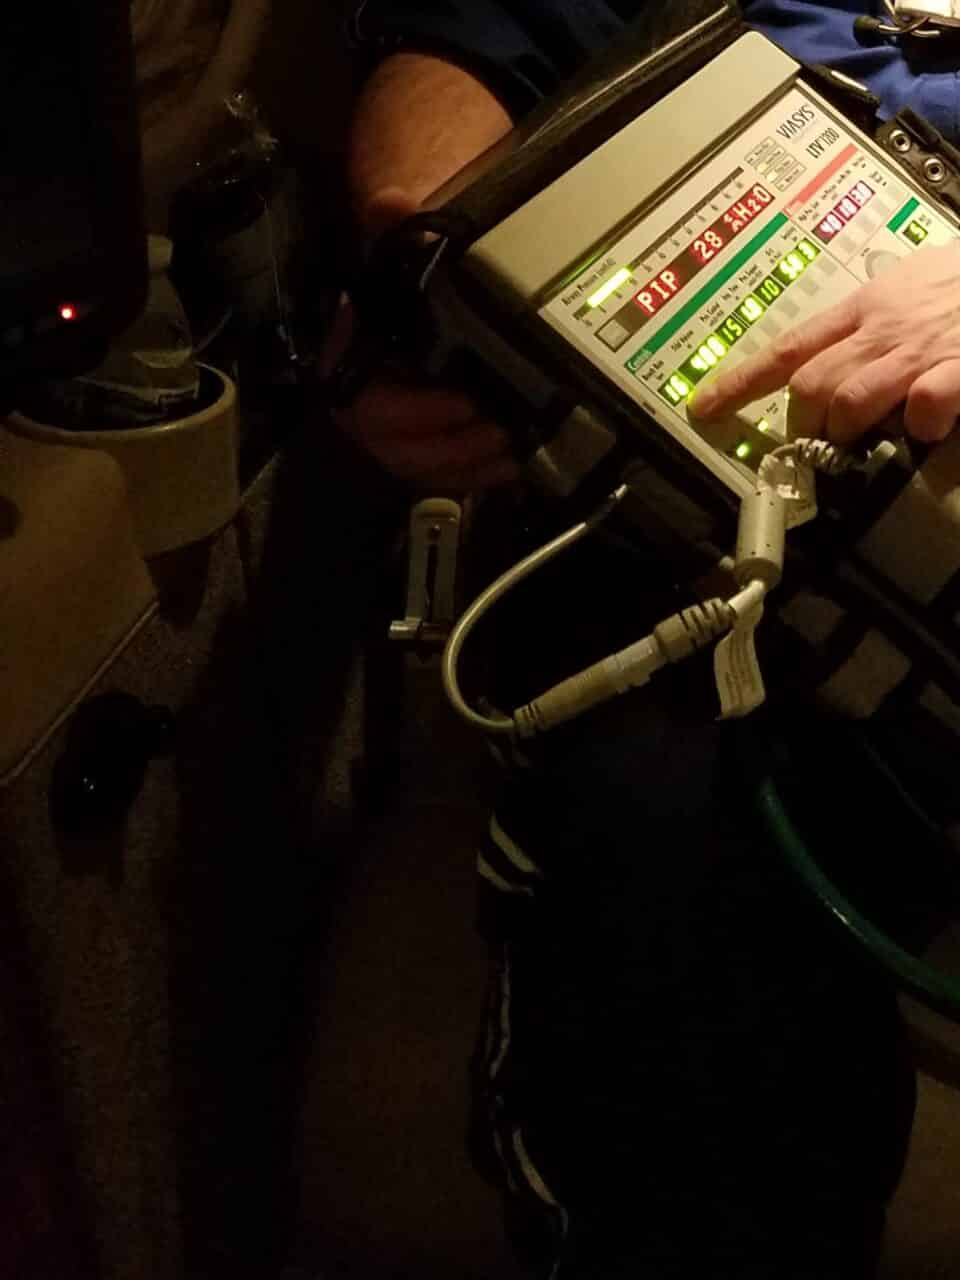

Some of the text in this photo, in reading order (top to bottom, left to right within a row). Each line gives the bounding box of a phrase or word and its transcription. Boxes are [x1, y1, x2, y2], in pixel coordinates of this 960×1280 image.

[775, 105, 815, 139] VIASYS
[818, 126, 840, 146] 1200
[819, 213, 843, 233] 40
[908, 221, 926, 240] 5
[636, 270, 680, 311] PIP
[693, 230, 723, 258] 28
[758, 278, 781, 300] 10
[720, 318, 744, 341] 15
[663, 375, 691, 401] 16
